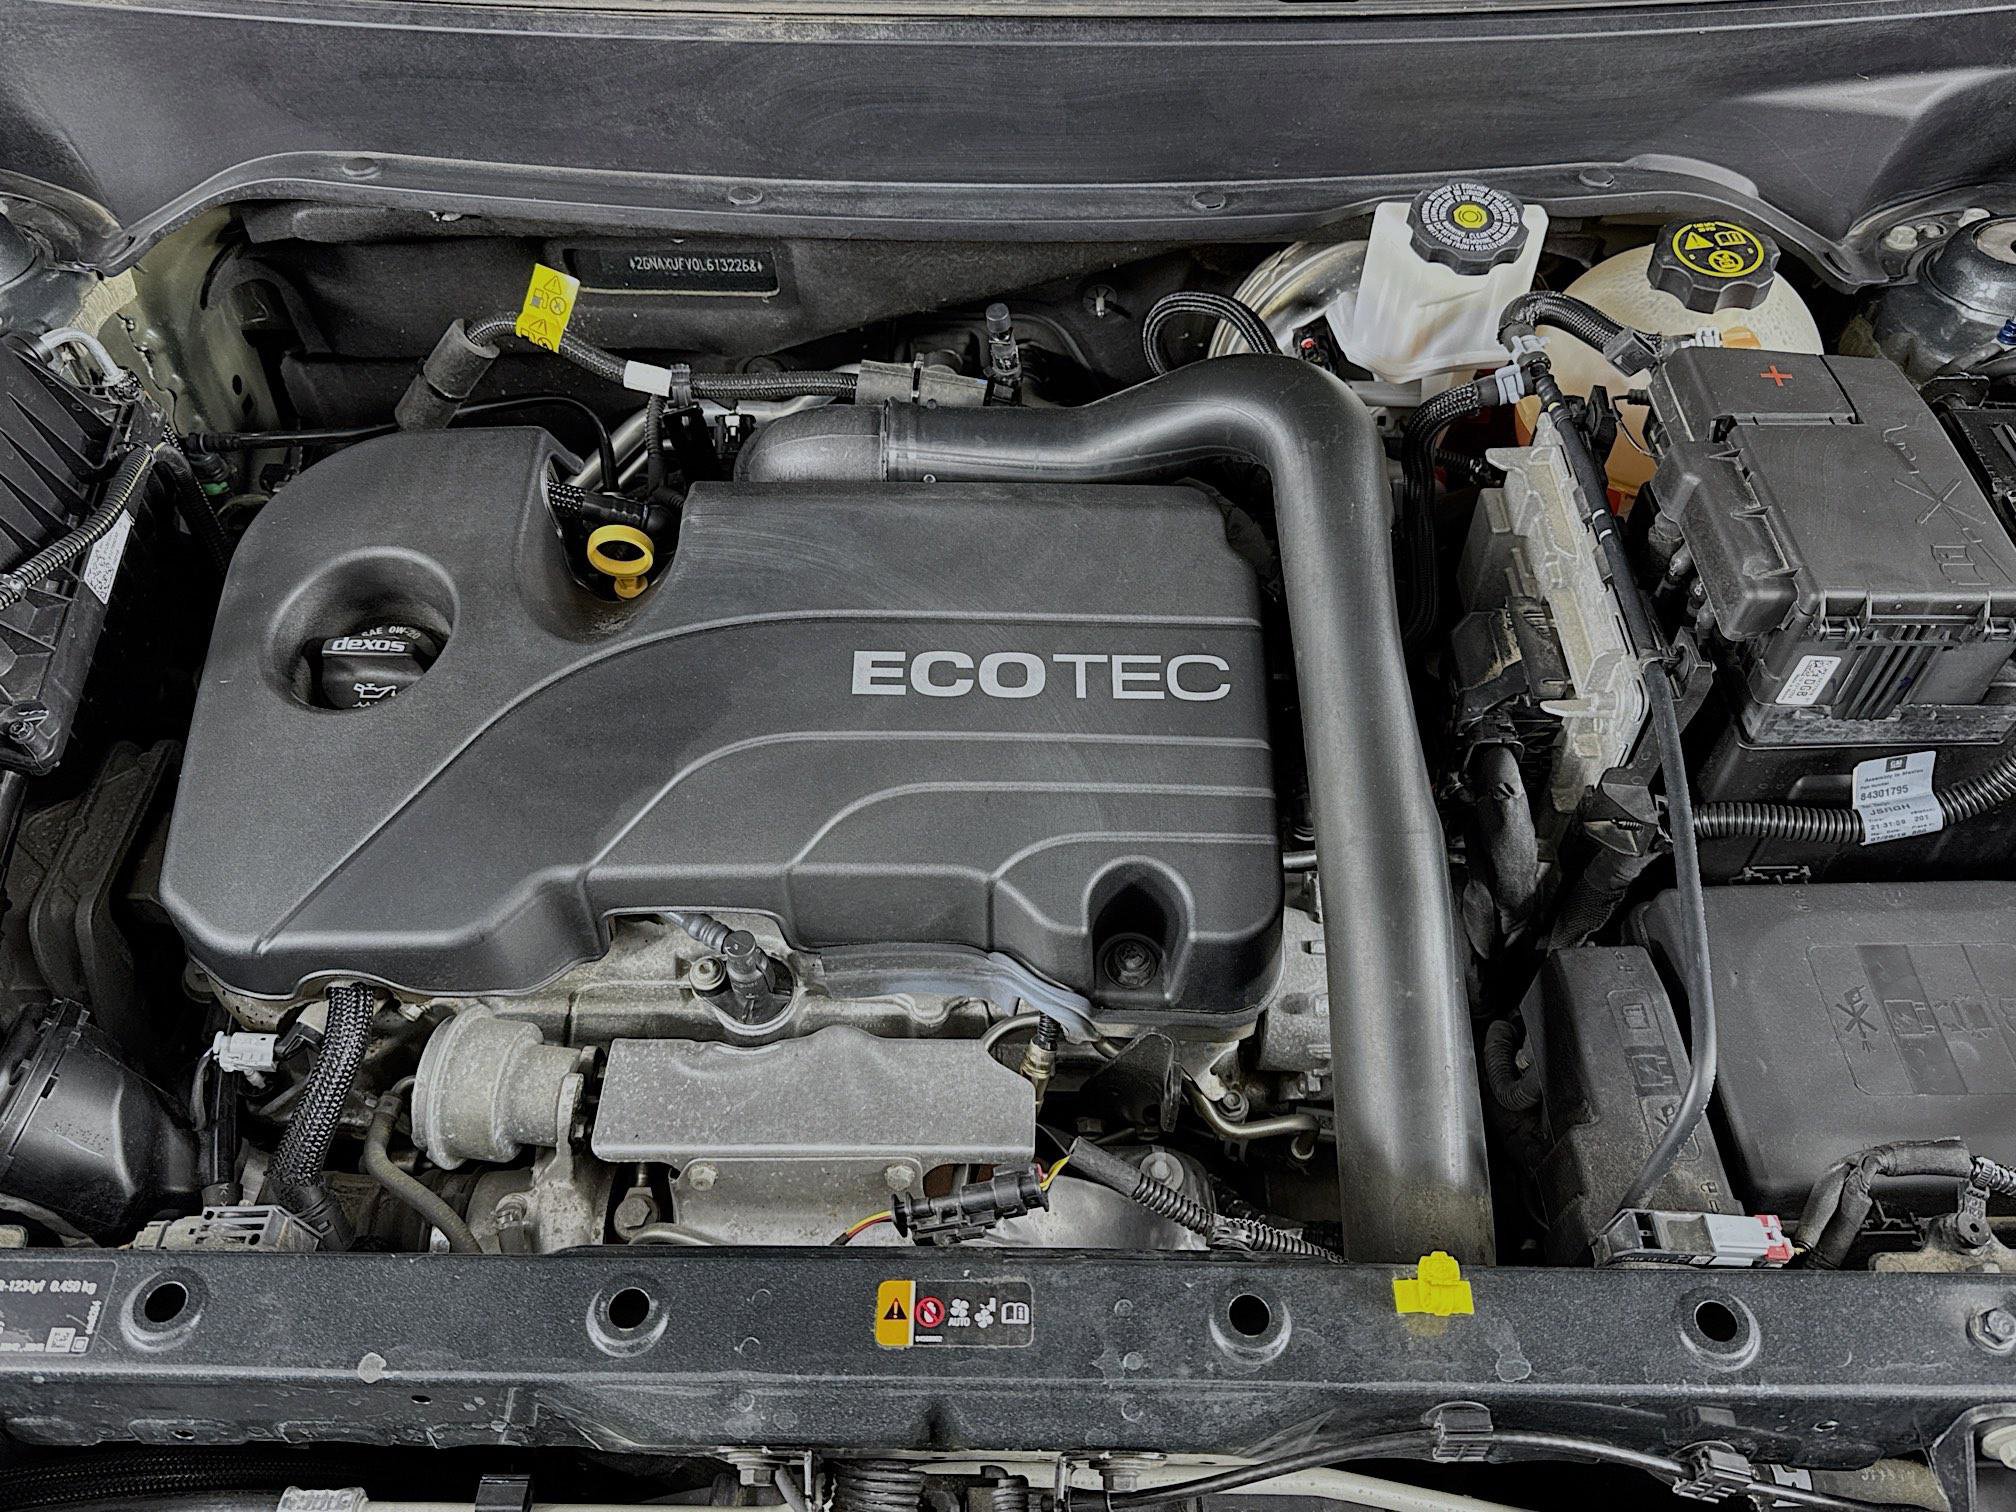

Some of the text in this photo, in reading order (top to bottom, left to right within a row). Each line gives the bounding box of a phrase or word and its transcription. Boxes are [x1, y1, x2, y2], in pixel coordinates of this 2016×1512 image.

[331, 637, 409, 652] dexos
[851, 650, 1231, 700] ECOTEC
[1860, 784, 1909, 801] 84301795
[948, 1316, 971, 1327] AUTO
